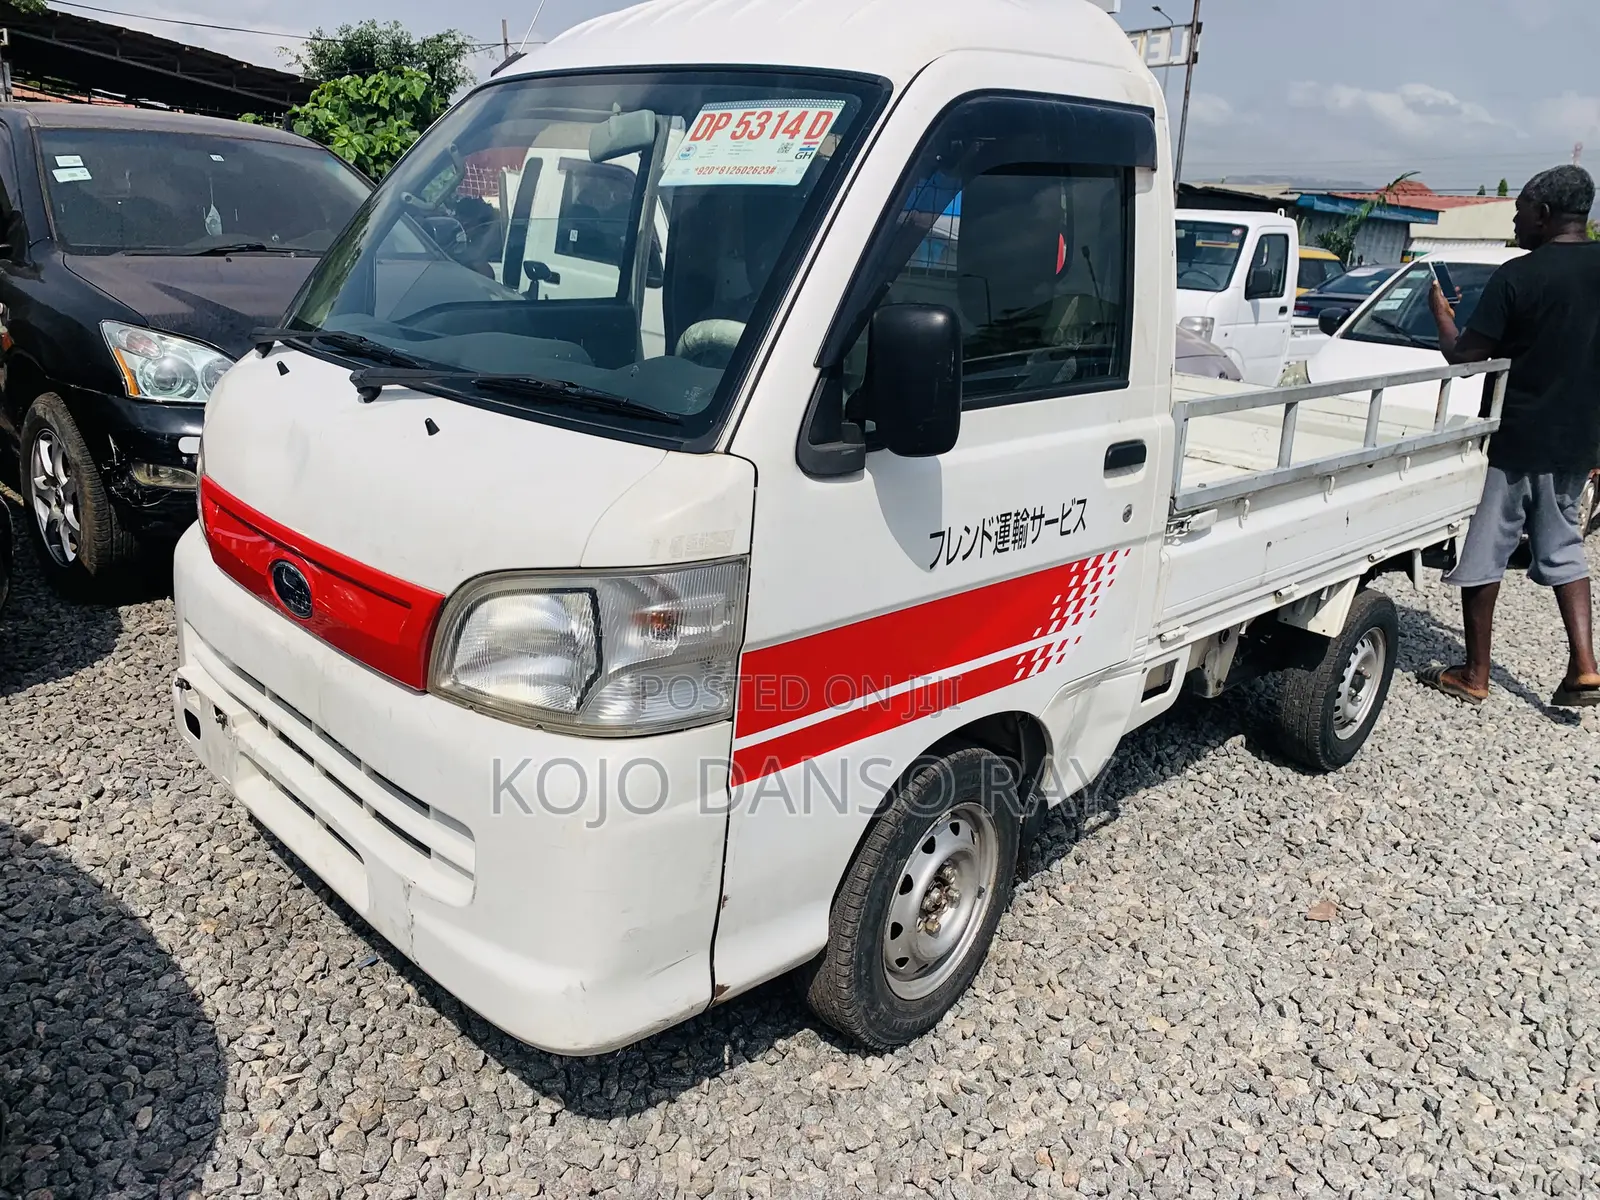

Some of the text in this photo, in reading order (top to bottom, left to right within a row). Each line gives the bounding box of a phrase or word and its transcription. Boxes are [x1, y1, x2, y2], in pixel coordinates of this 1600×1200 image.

[689, 110, 834, 142] DP 5314 D
[795, 151, 813, 160] GH
[929, 497, 1088, 571] フレンド運輸サービス
